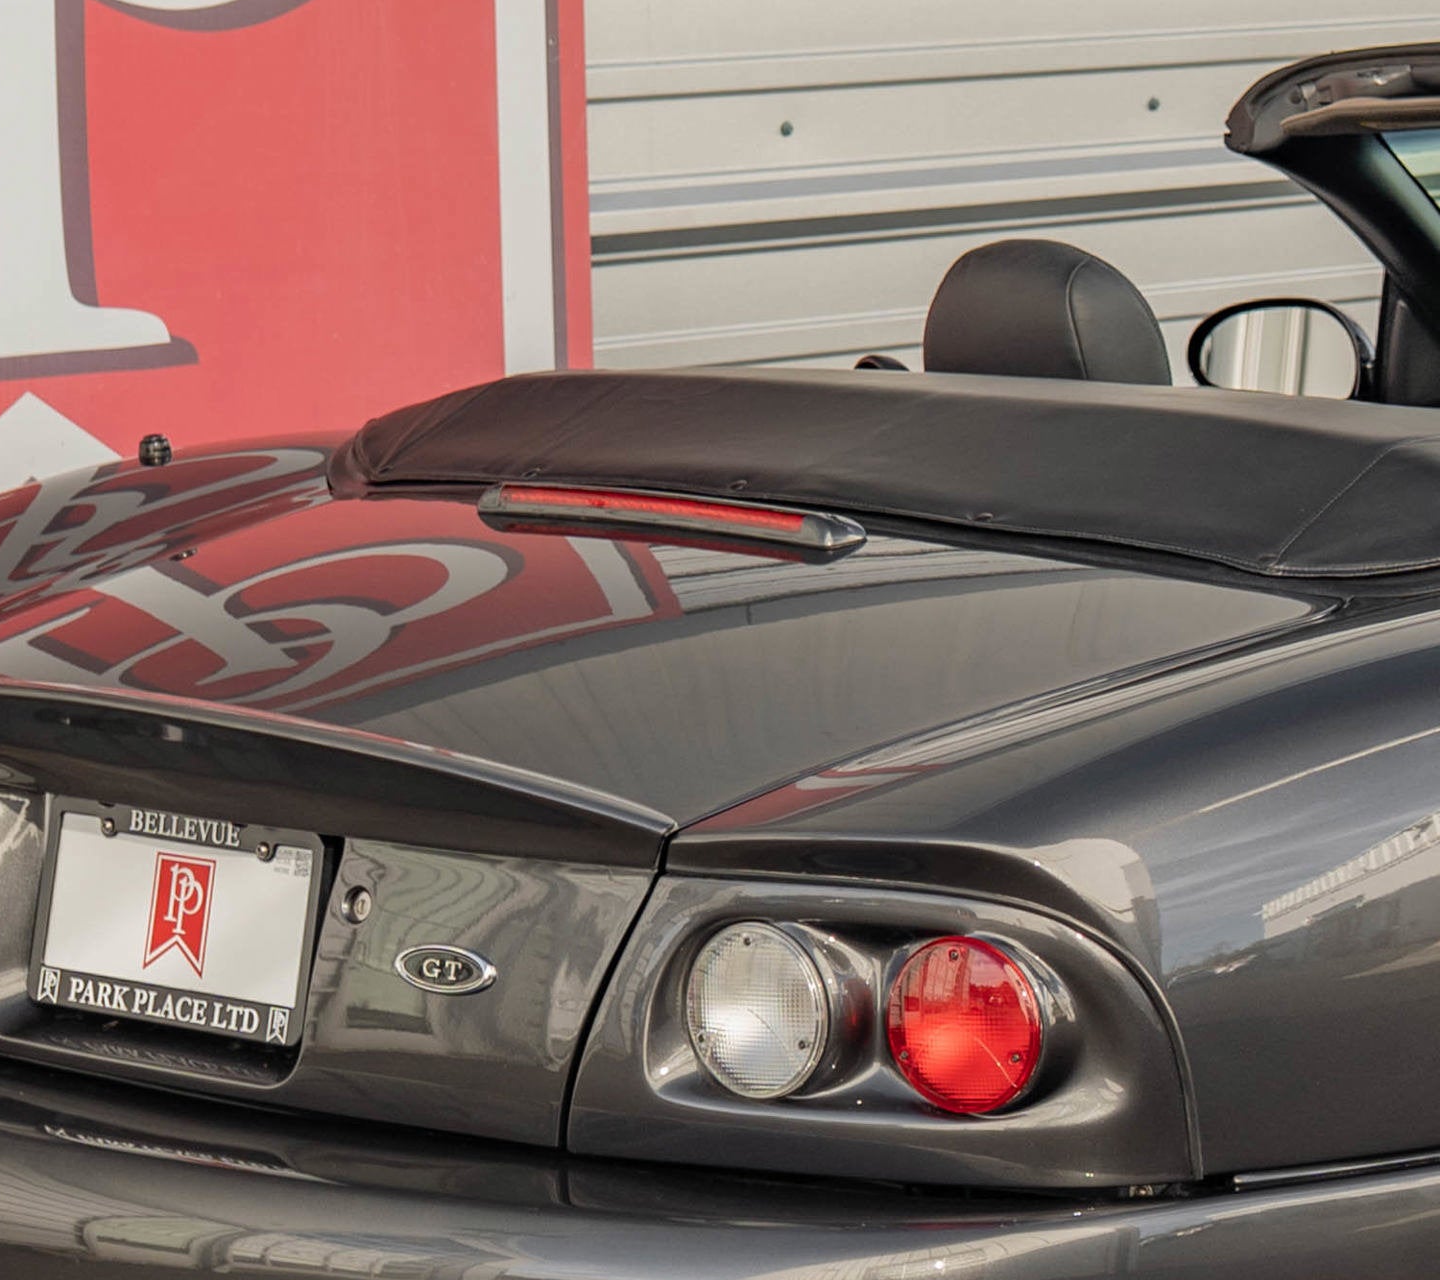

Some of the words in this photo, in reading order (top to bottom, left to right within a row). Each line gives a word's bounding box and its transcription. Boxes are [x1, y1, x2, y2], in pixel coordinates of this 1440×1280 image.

[129, 809, 240, 847] BELLEVUE
[422, 958, 462, 981] GT
[67, 976, 129, 1012] PARK
[131, 988, 207, 1026] PLACE
[210, 1001, 260, 1034] LTD
